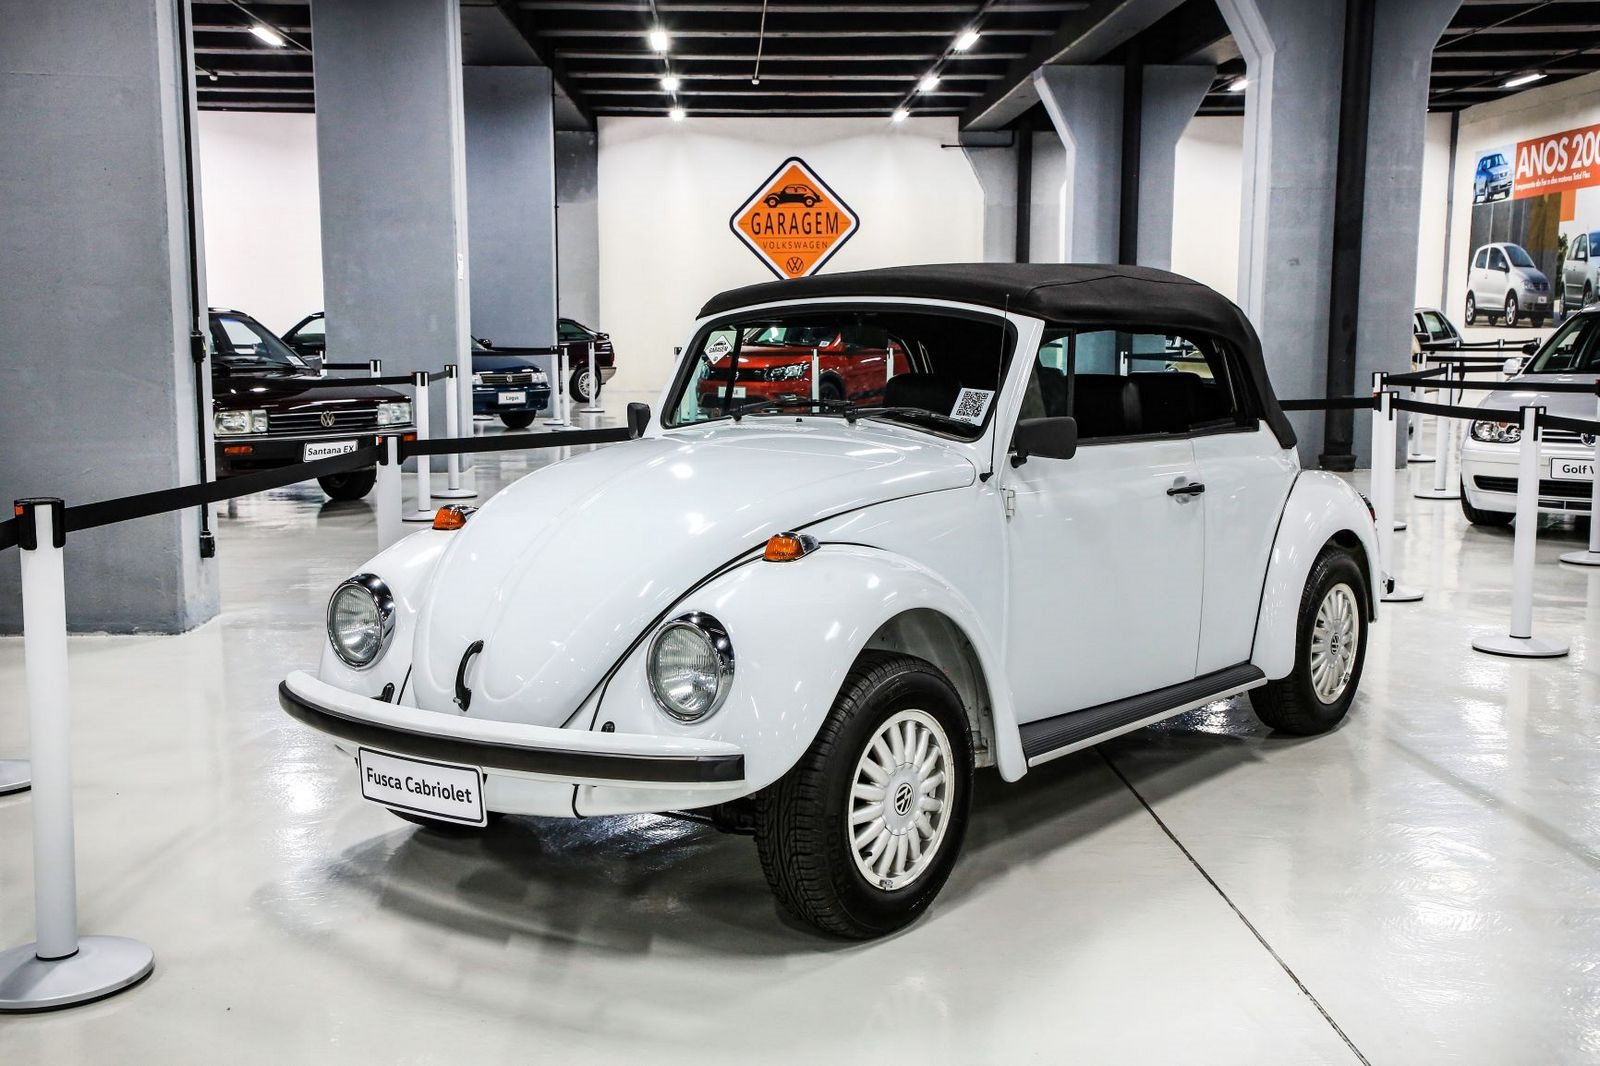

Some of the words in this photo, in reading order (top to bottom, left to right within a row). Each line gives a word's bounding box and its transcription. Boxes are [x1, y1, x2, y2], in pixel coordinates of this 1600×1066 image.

[1515, 136, 1569, 180] ANOS
[751, 212, 839, 235] GARAGEM
[762, 241, 828, 249] VOLKSWAGEN
[307, 447, 342, 456] Santana
[343, 445, 354, 453] EX
[1562, 464, 1587, 474] Golf
[366, 766, 402, 791] Fusca
[405, 776, 473, 804] Cabriolet
